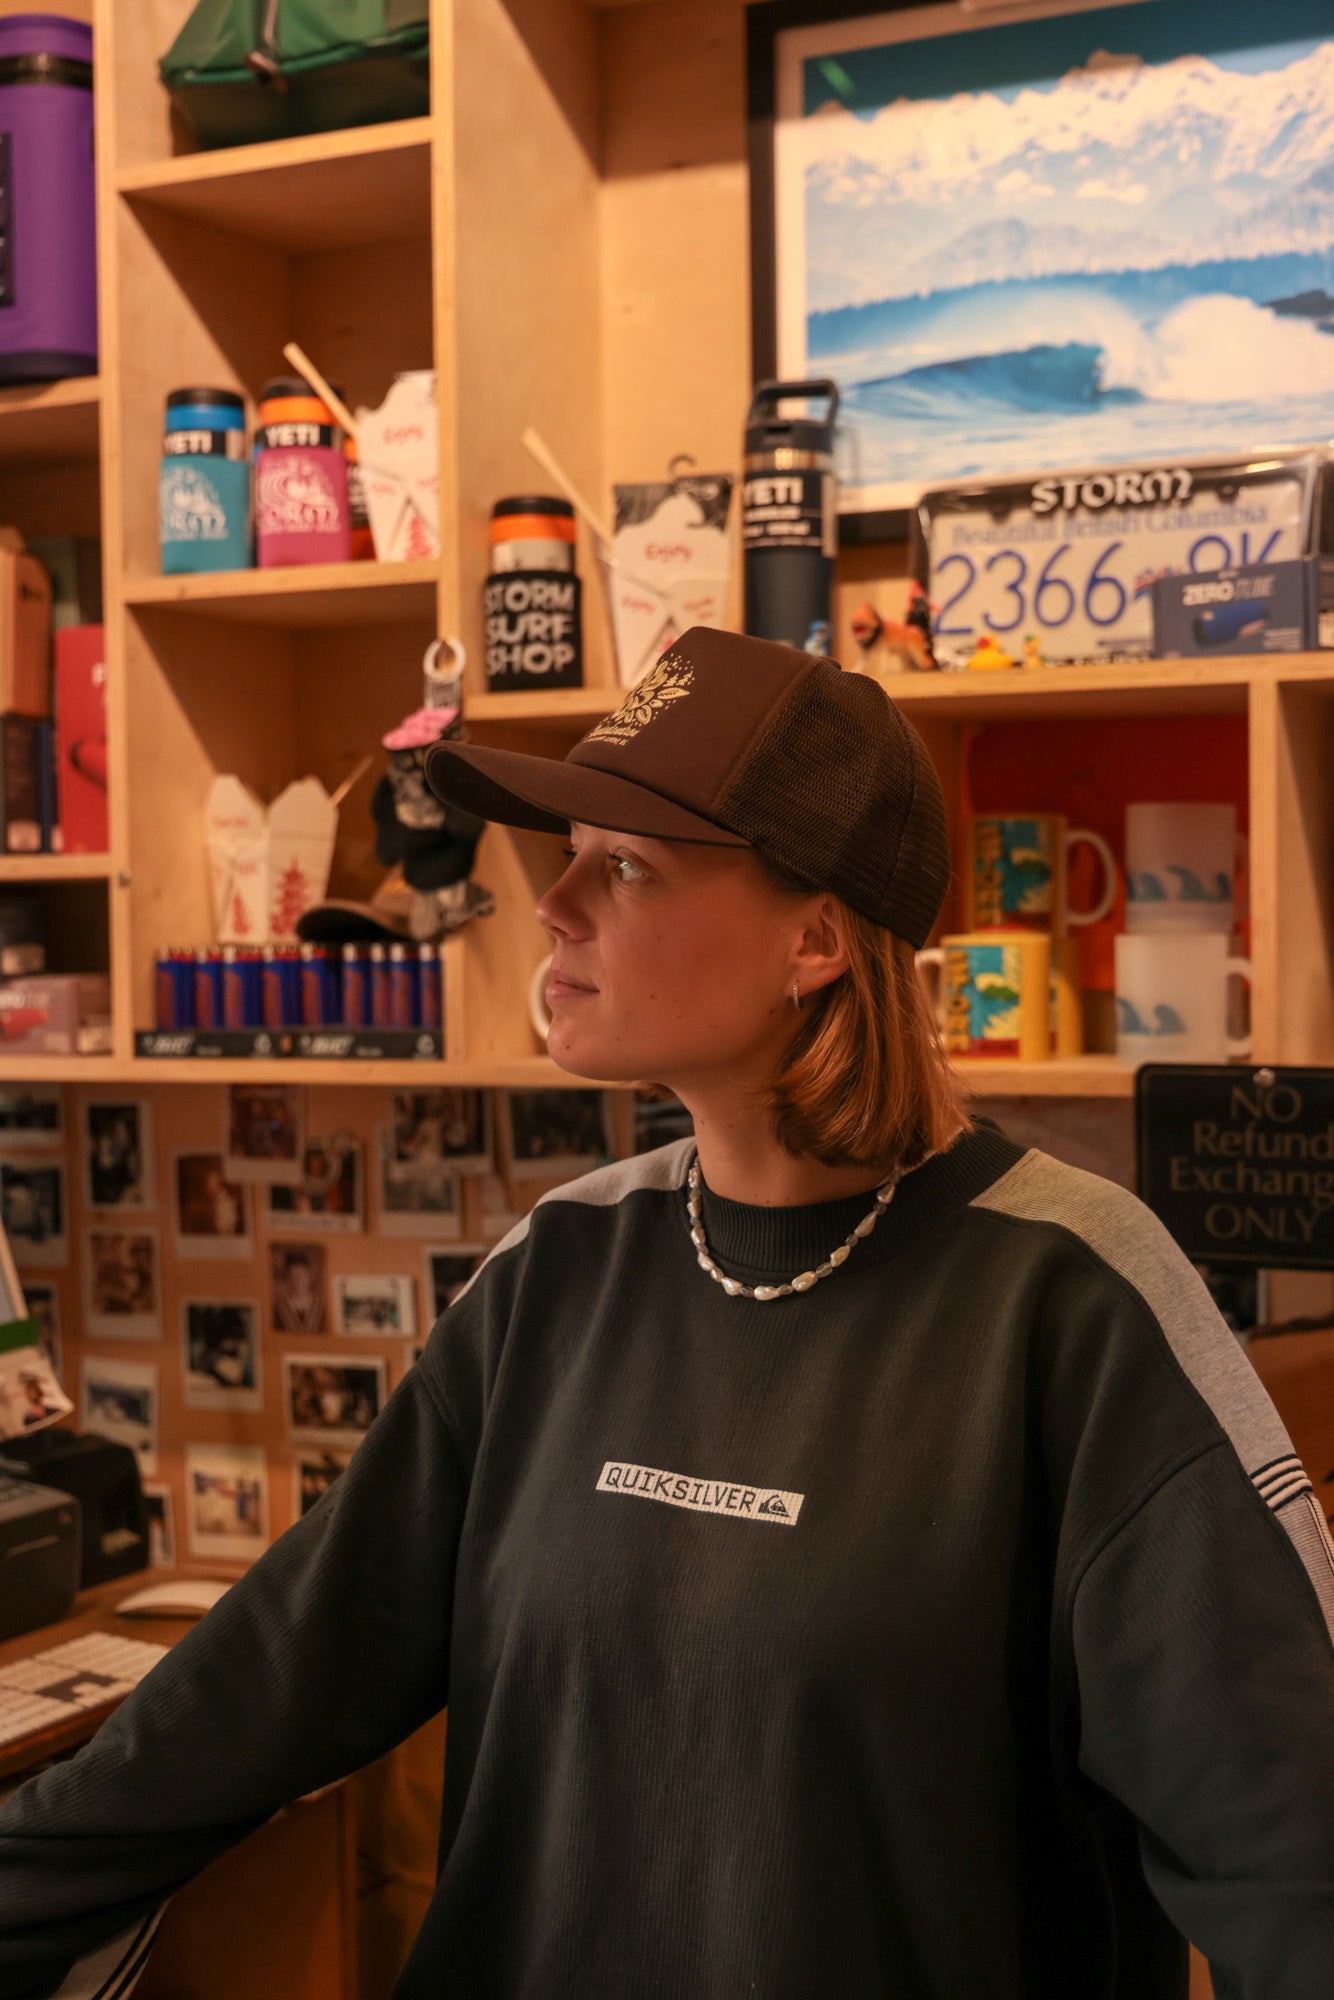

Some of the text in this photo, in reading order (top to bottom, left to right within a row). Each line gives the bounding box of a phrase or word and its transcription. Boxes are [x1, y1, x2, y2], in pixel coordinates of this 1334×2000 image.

[266, 424, 320, 447] YETI
[1030, 469, 1194, 513] STORM
[952, 502, 1269, 546] Beautiful British Columbia
[485, 580, 575, 615] STORM
[934, 541, 1126, 635] 2366
[486, 614, 573, 646] SURF
[486, 643, 575, 675] SHOP
[1231, 1084, 1302, 1123] NO
[1204, 1201, 1321, 1243] ONLY
[605, 1466, 757, 1513] QUIKSILVER
